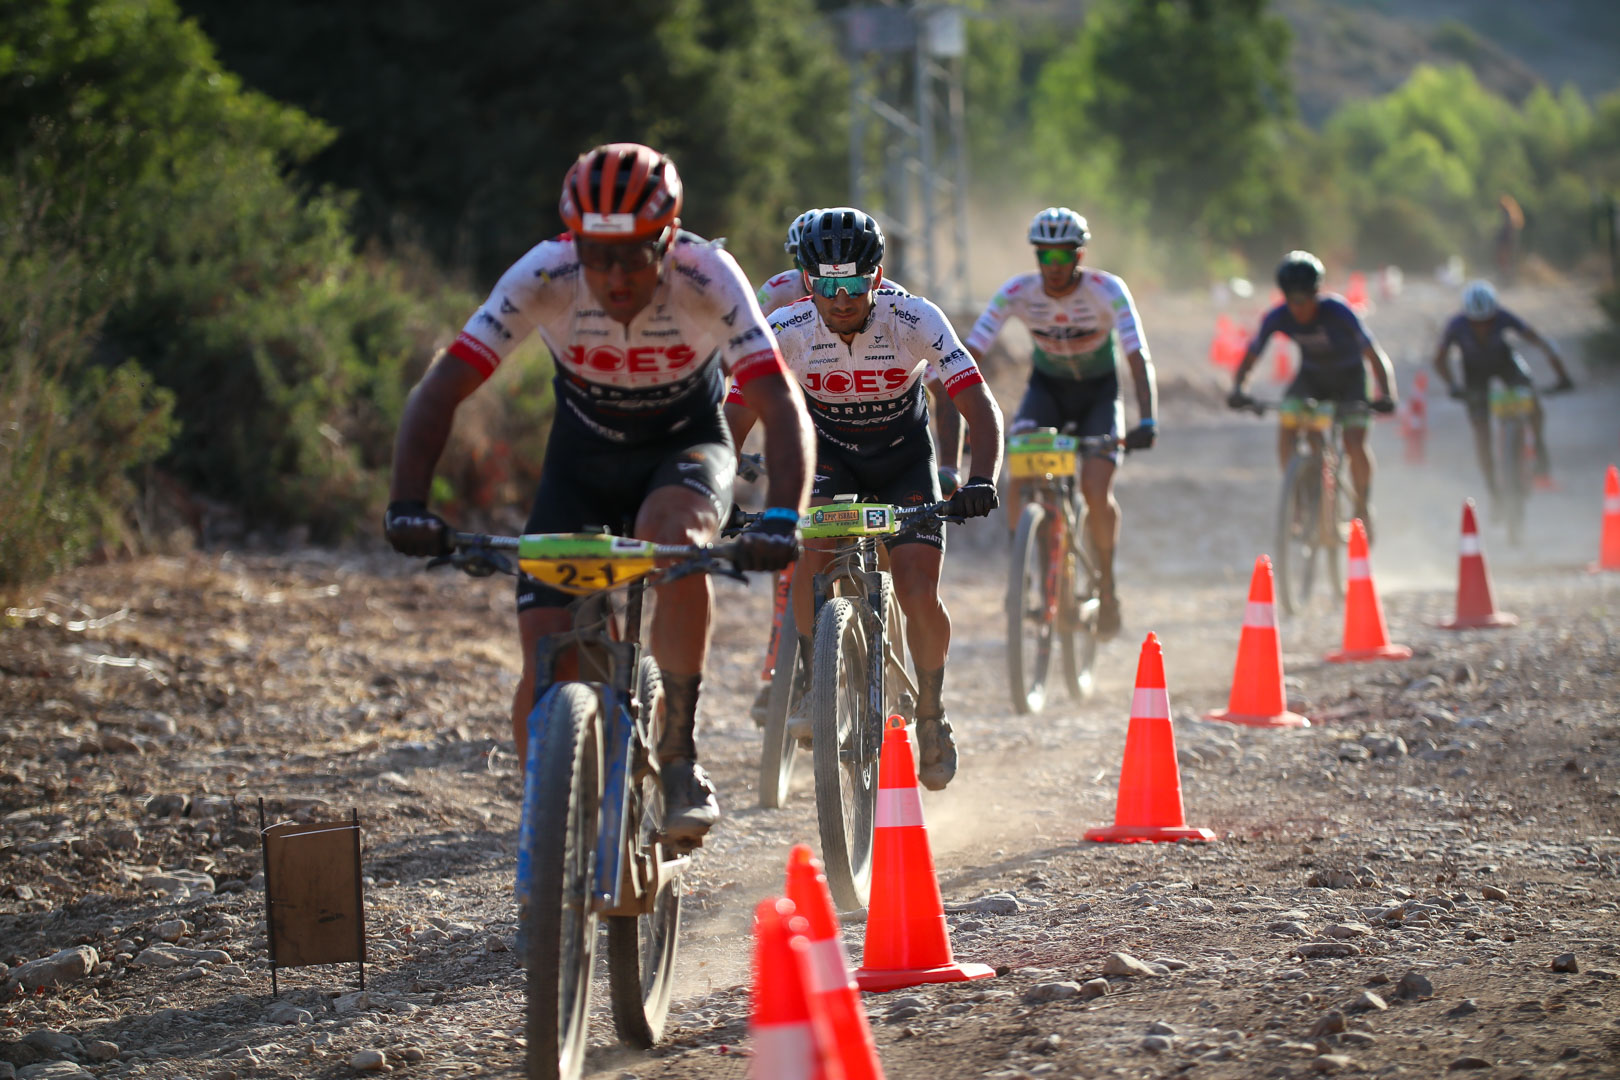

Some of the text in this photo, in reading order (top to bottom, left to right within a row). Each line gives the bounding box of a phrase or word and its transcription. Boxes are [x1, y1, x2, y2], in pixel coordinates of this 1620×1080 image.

[781, 310, 813, 329] weber
[895, 308, 920, 325] weber
[563, 344, 696, 374] JOE'S
[804, 367, 909, 394] JOE'S
[556, 562, 615, 588] 2-1
